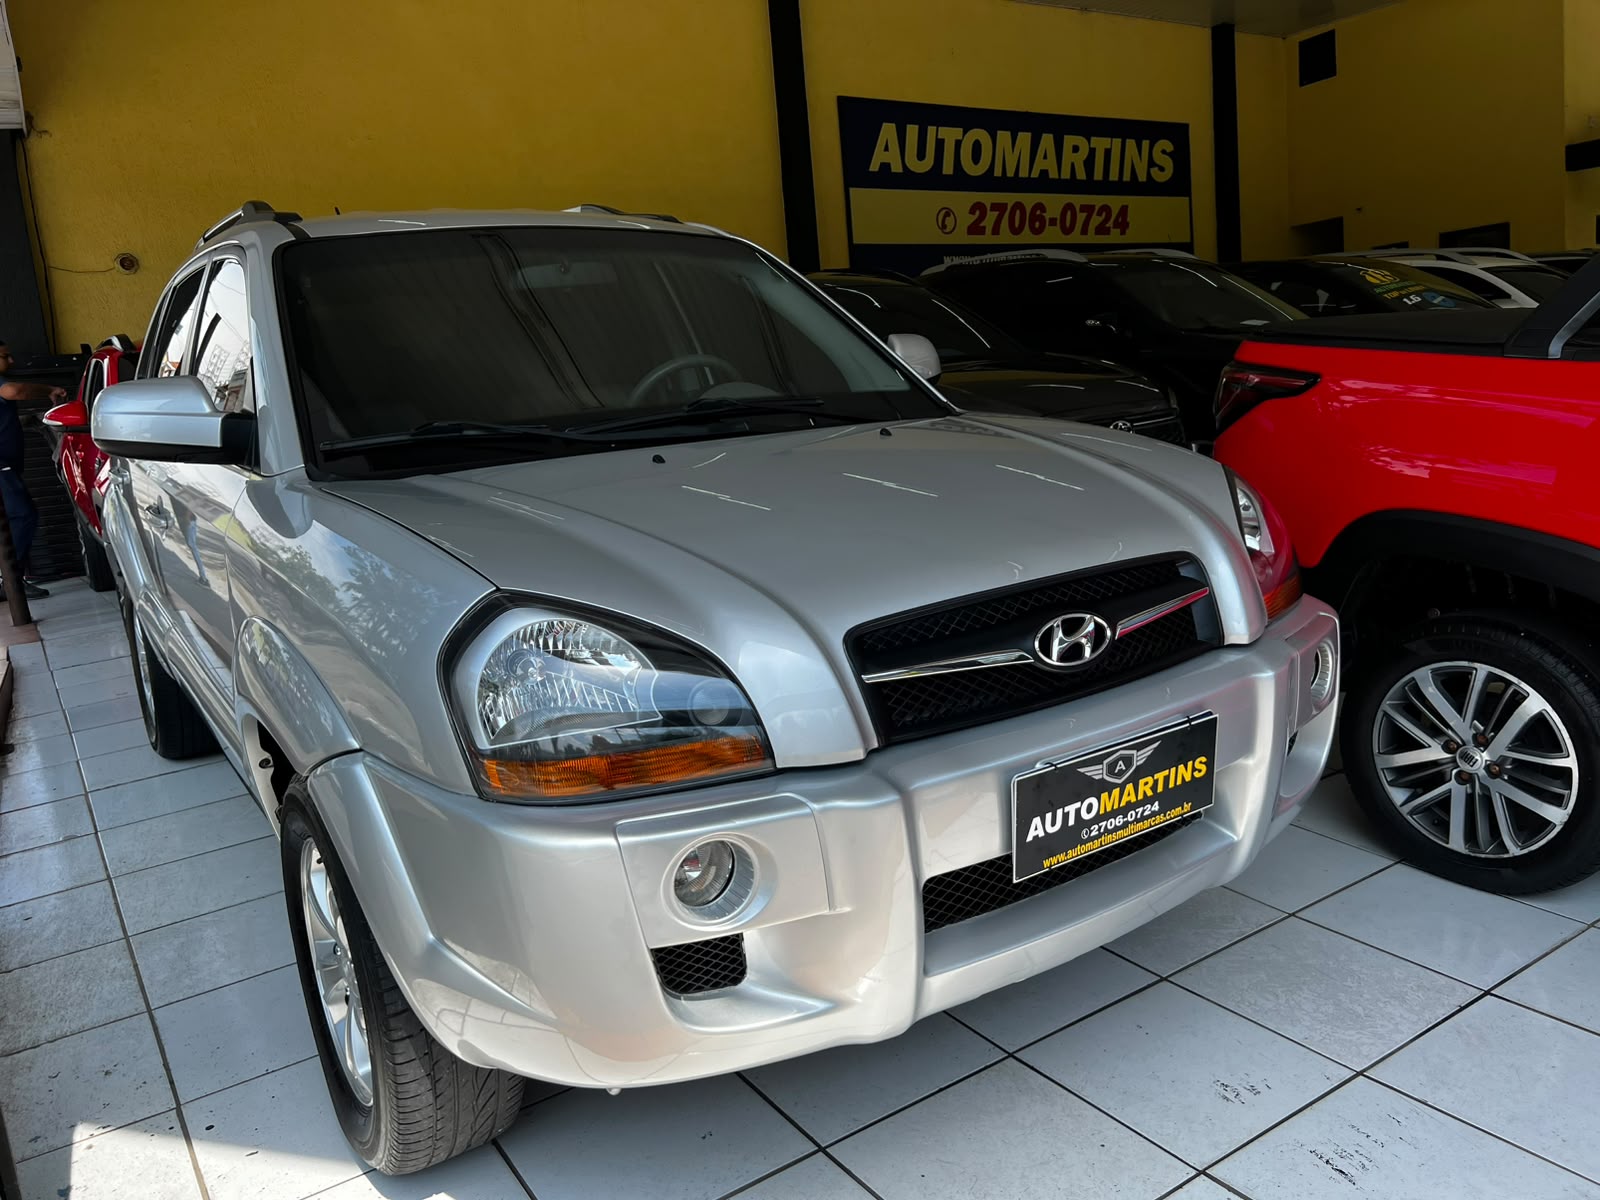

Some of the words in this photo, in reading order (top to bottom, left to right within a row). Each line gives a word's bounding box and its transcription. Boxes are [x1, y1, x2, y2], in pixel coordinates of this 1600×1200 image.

[868, 122, 1175, 183] AUTOMARTINS
[966, 201, 1130, 236] 2706-0724
[1114, 760, 1126, 773] A
[1026, 756, 1208, 843] AUTOMARTINS
[1089, 801, 1160, 837] 2706-0724
[1043, 801, 1193, 869] www.automartinsmultimarcas.com.br
